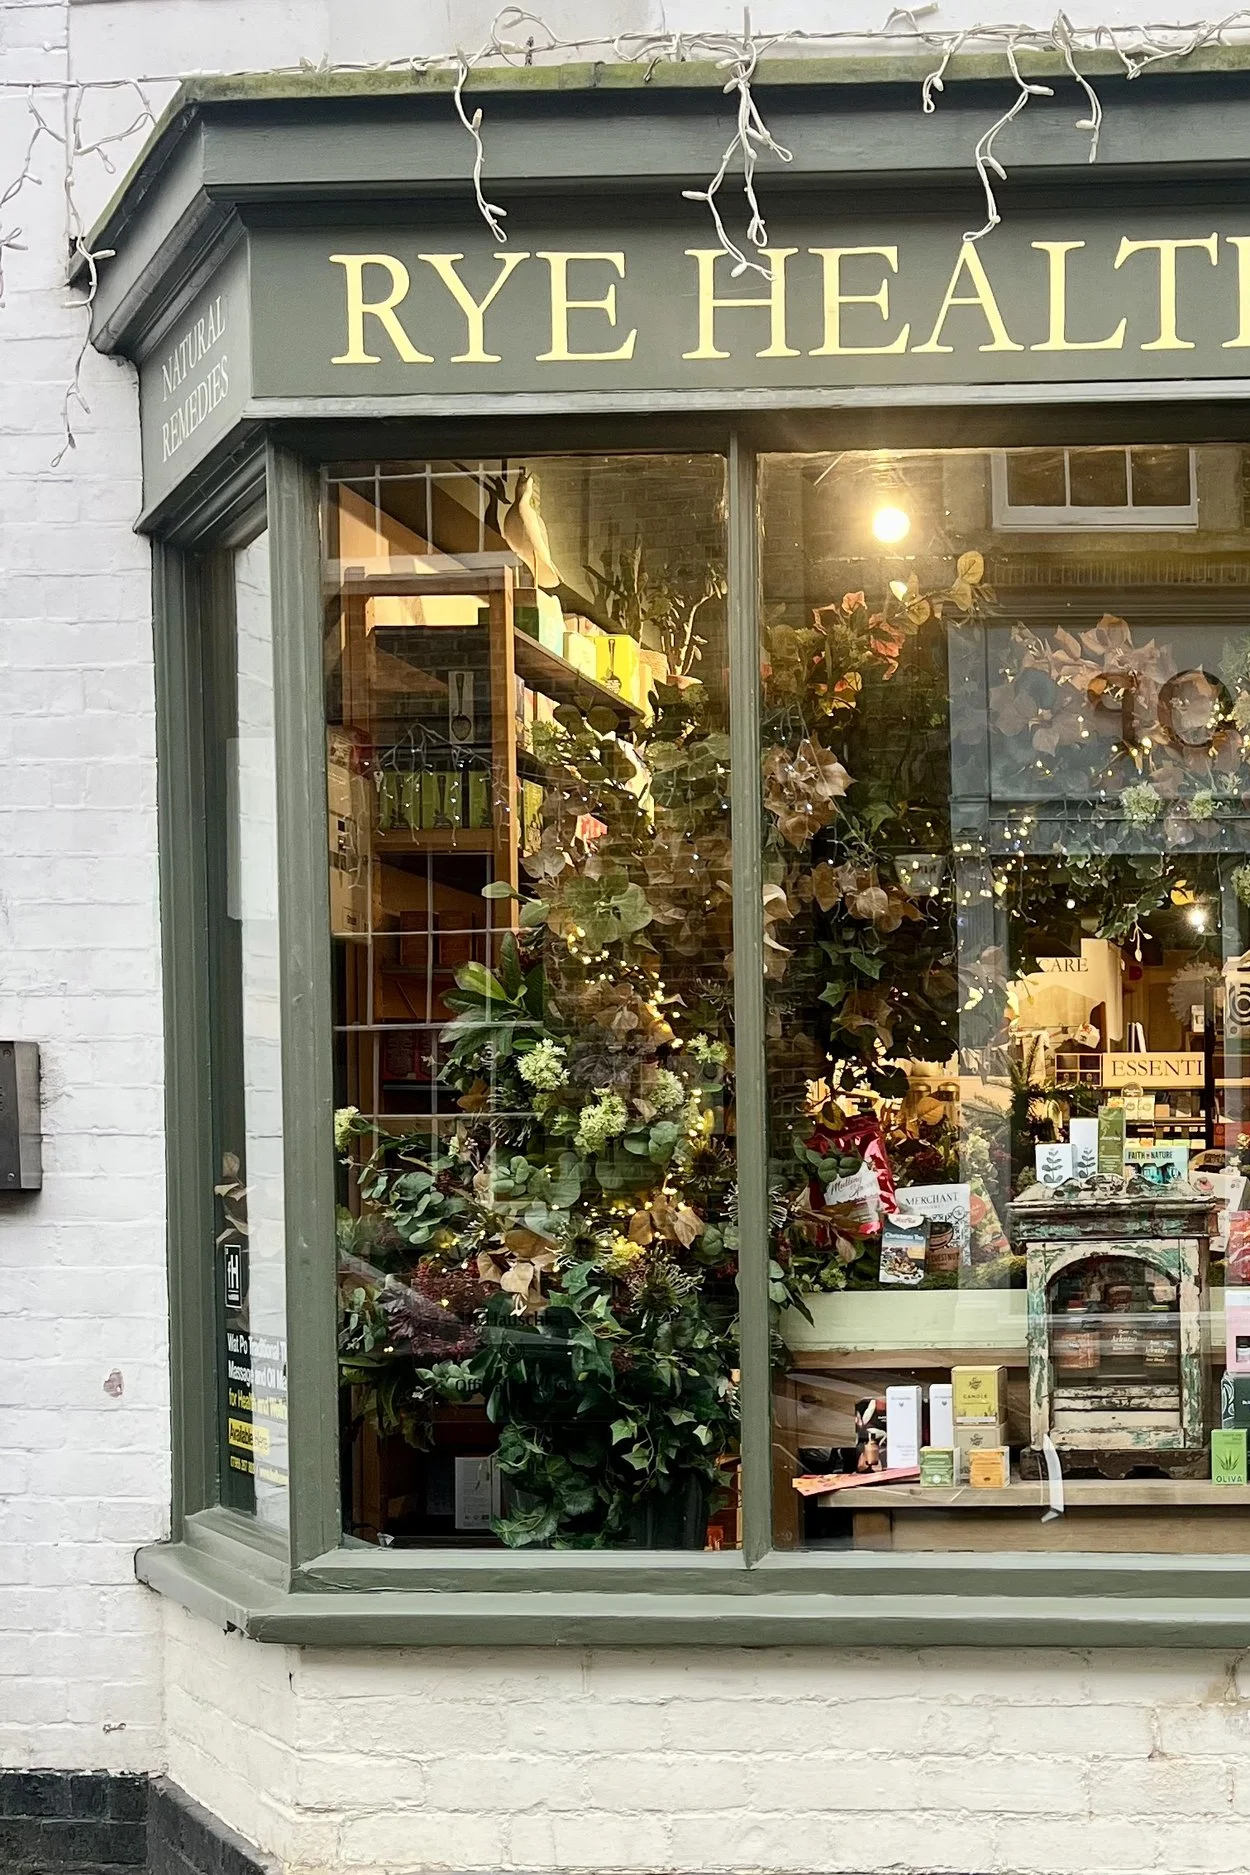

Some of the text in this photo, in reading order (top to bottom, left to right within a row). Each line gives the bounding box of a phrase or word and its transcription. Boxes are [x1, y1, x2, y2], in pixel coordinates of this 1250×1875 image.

[329, 250, 638, 365] RYE
[162, 296, 226, 402] NATURAL
[162, 355, 229, 462] REMEDIES
[1128, 1151, 1146, 1160] FAITH
[1151, 1151, 1173, 1160] NATURE
[906, 1191, 958, 1206] MERCHANT
[1216, 1475, 1243, 1483] OLIVA
